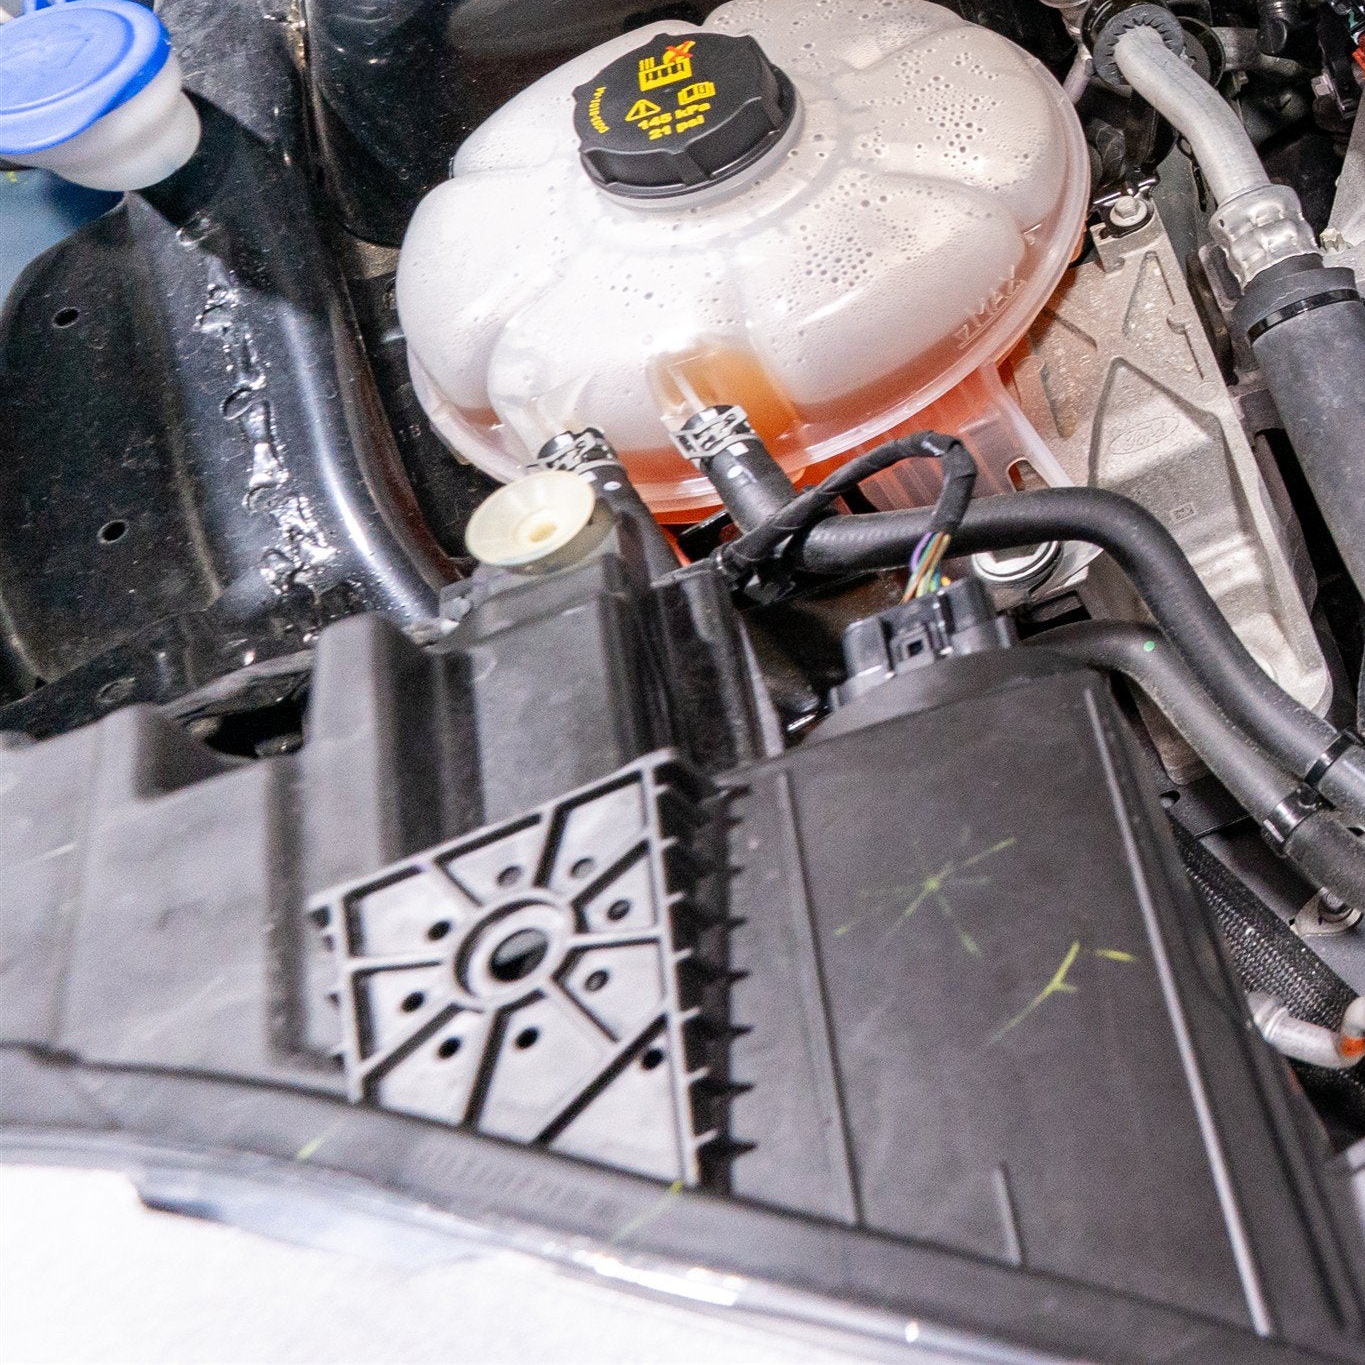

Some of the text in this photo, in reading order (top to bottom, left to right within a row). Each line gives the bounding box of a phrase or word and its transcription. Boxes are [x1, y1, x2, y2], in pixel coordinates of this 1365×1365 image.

[638, 102, 711, 130] 145 kPa
[648, 115, 705, 140] 21 psi
